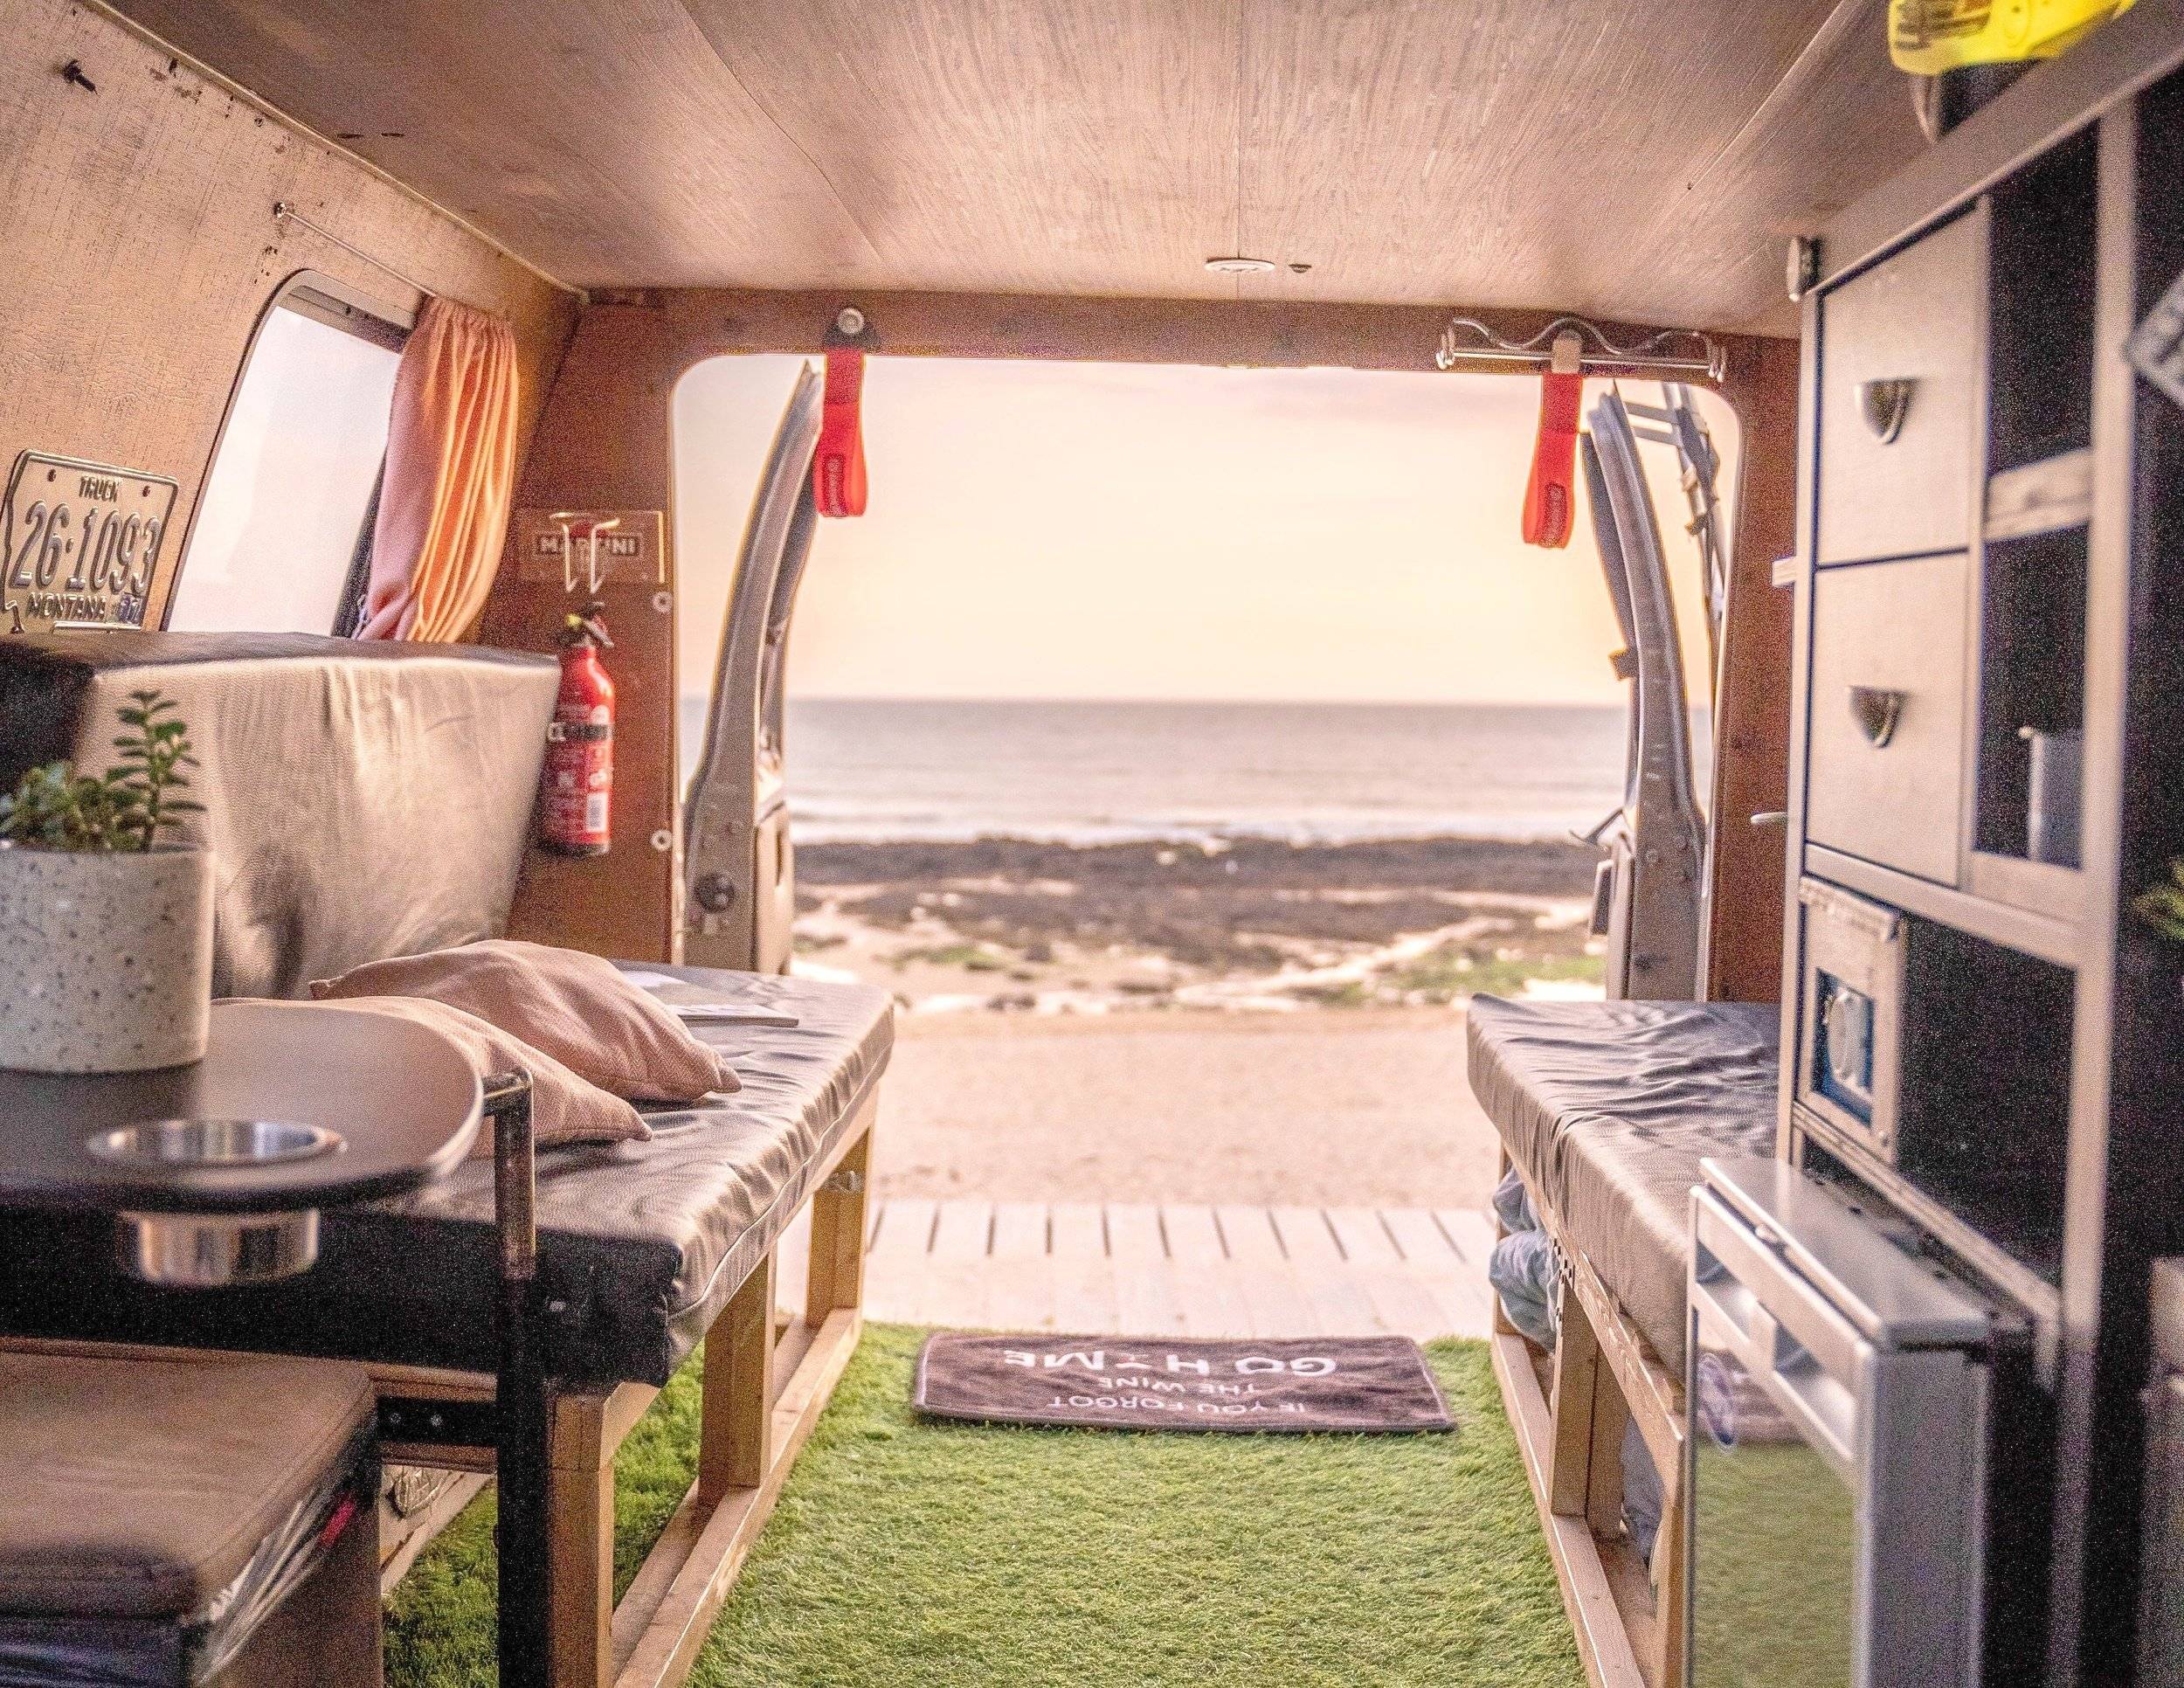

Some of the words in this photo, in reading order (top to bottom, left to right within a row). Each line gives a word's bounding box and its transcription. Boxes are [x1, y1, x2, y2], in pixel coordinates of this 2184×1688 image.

[79, 475, 121, 502] TRUCK
[25, 592, 107, 619] MONTANA
[1235, 1357, 1337, 1377] GO
[1097, 1376, 1185, 1394] WINE
[1199, 1382, 1261, 1395] THE
[1047, 1395, 1185, 1411] FORGOT
[1197, 1401, 1267, 1414] YOU
[1280, 1403, 1306, 1413] IF
